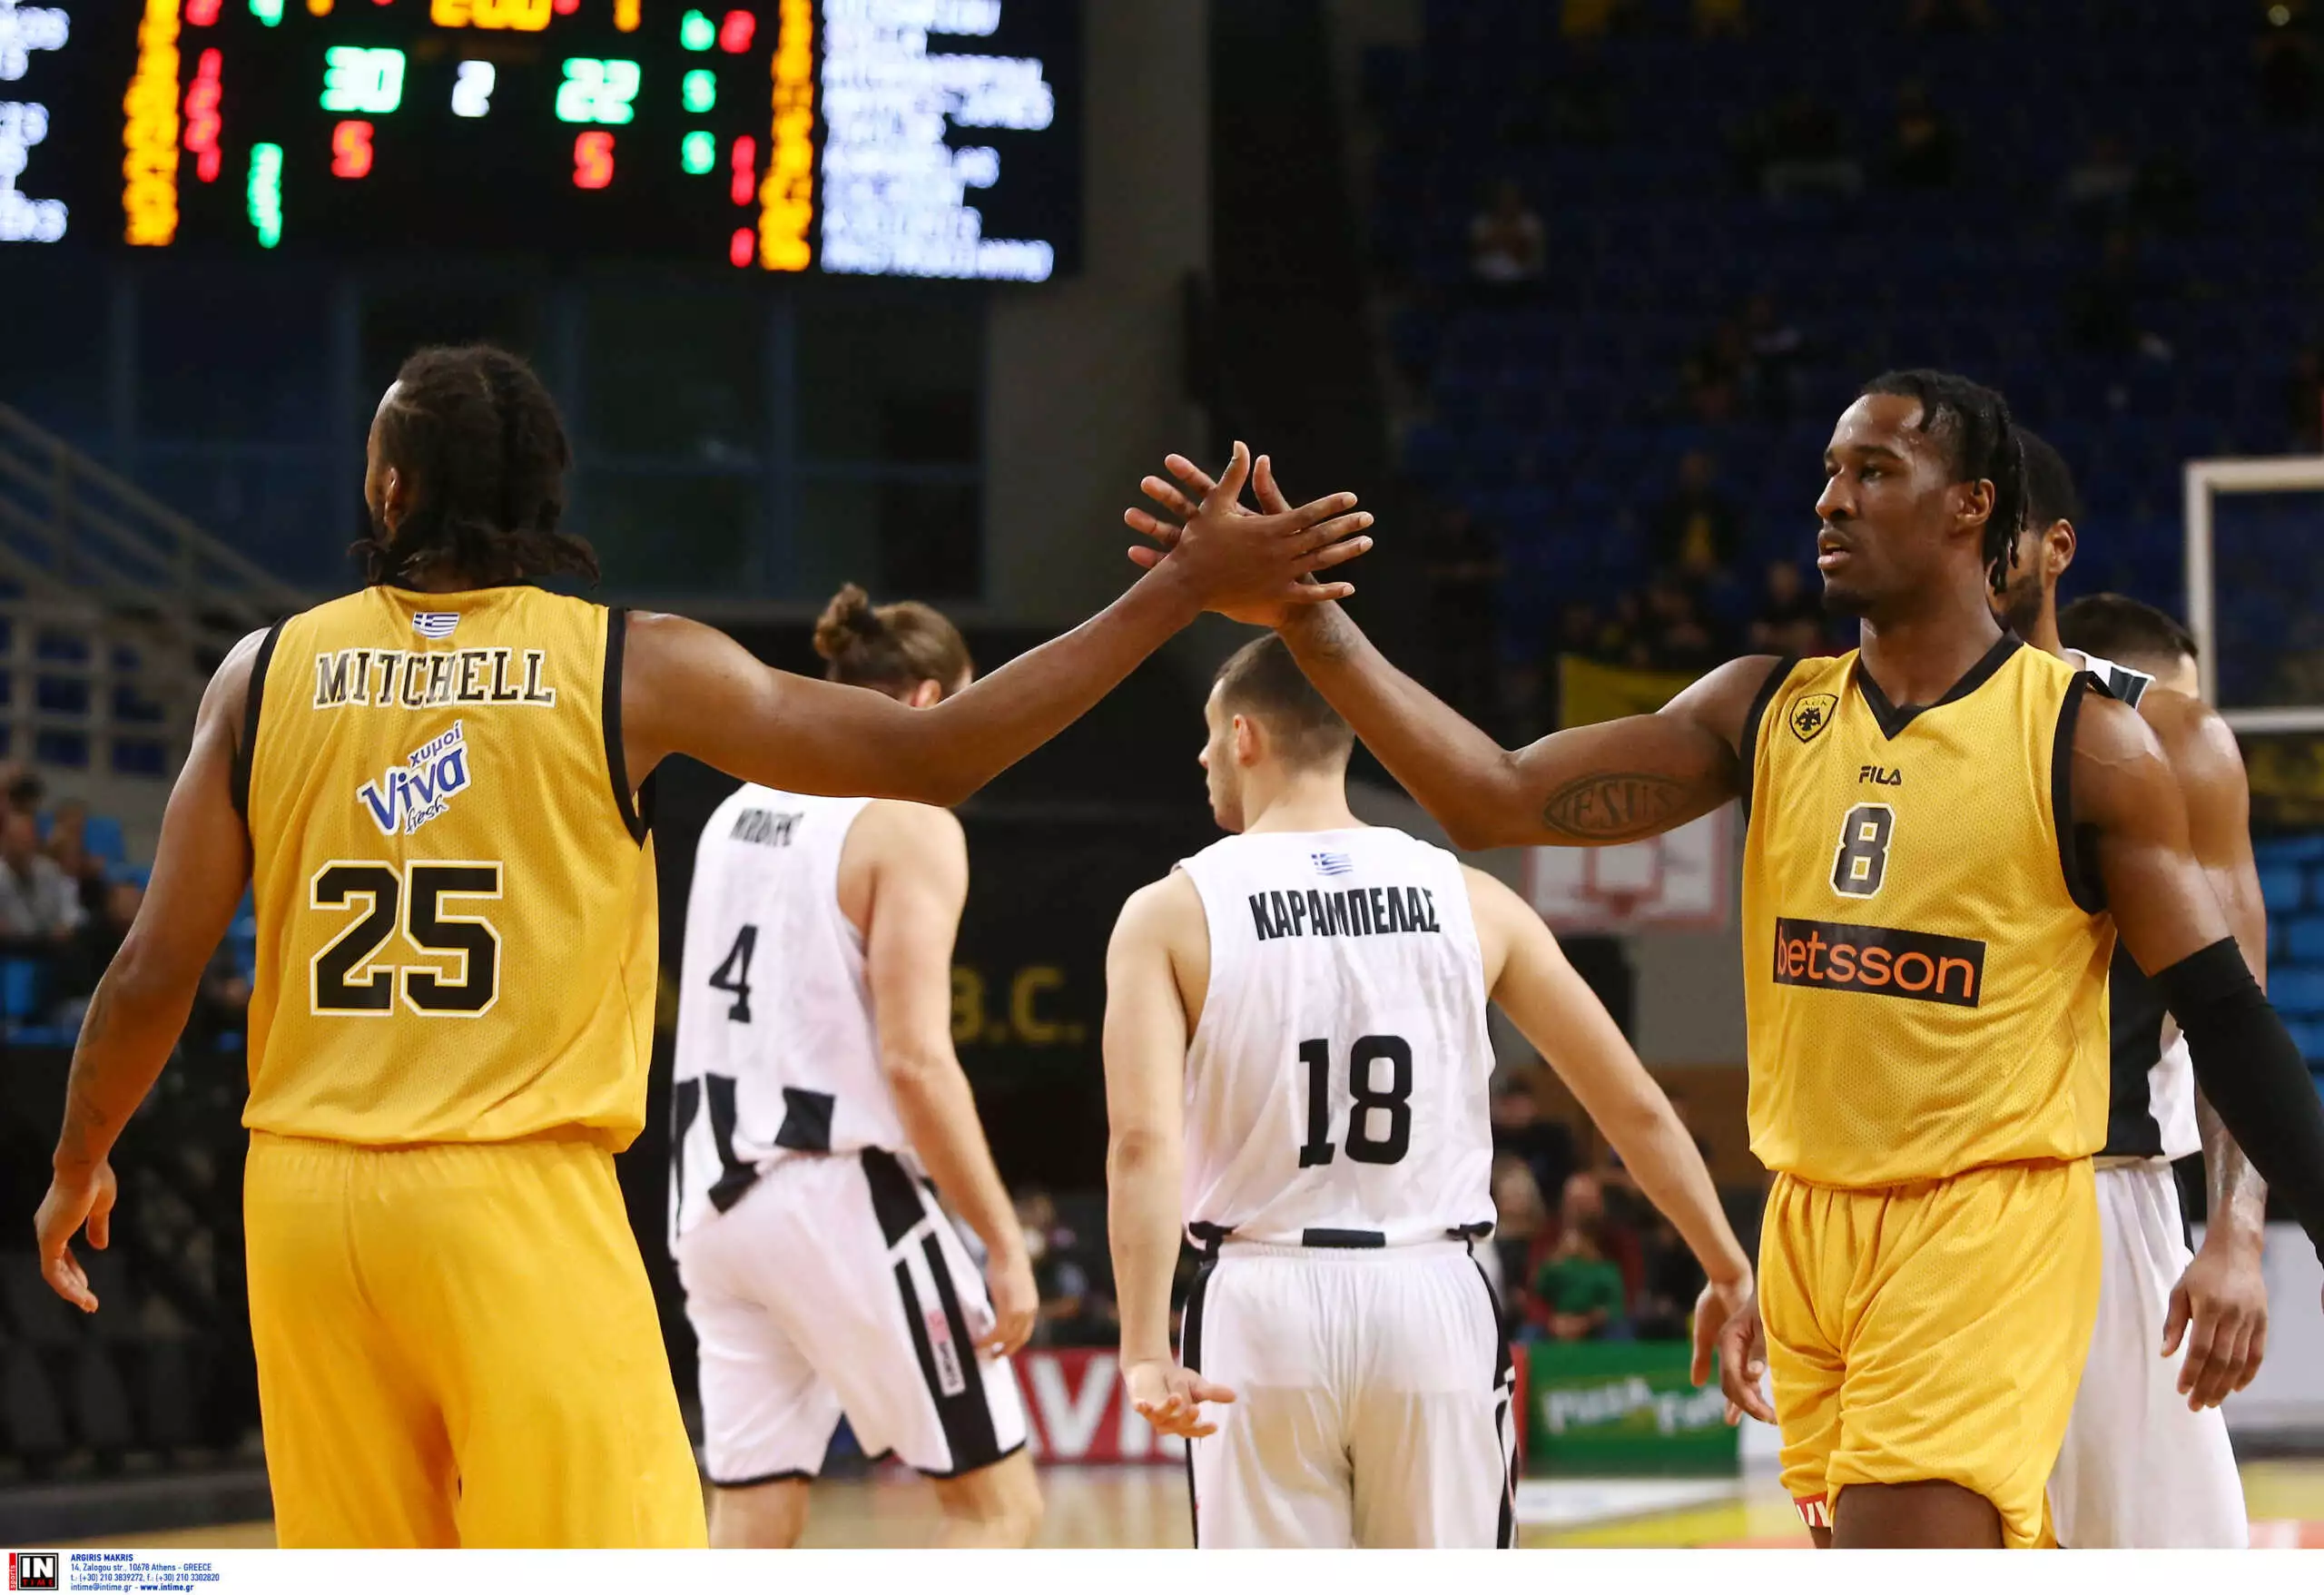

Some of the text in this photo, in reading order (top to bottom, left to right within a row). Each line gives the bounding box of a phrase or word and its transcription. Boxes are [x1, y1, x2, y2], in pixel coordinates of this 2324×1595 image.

[320, 46, 641, 124] 30 2 22
[314, 647, 556, 709] MITCHELL
[361, 747, 466, 830] Viva
[1859, 765, 1902, 785] FILA
[1829, 802, 1896, 900] 8
[310, 860, 503, 1018] 25
[709, 924, 758, 1024] 4
[1777, 926, 1974, 998] betsson
[1298, 1035, 1413, 1168] 18
